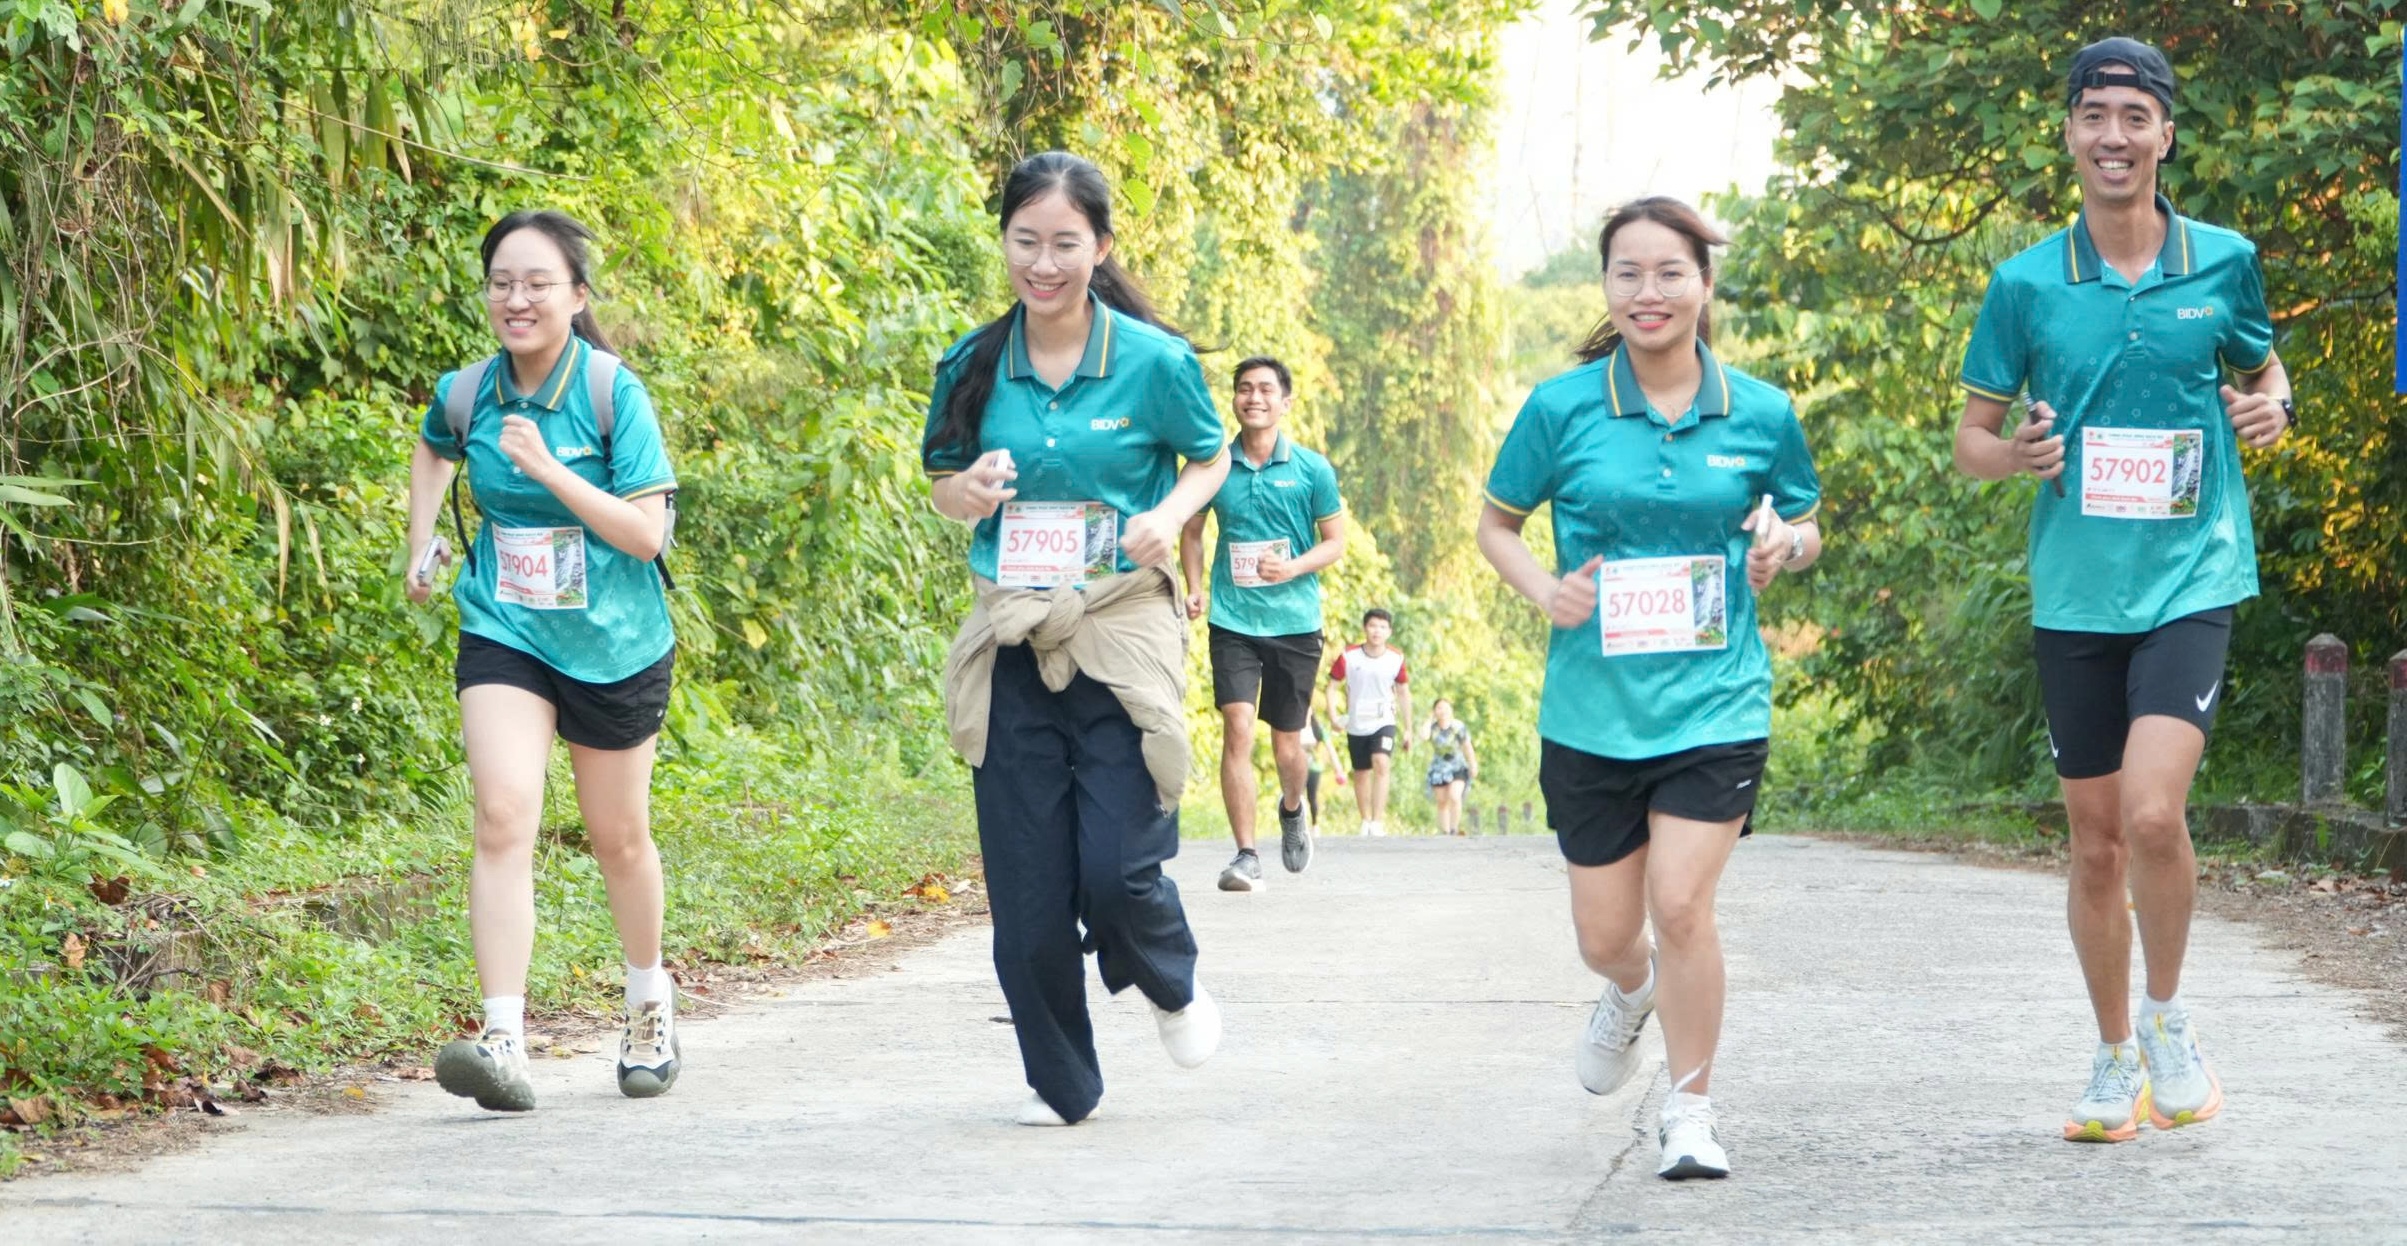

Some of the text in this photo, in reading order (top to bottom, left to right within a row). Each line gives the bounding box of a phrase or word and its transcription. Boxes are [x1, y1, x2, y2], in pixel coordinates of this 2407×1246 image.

[2176, 307, 2204, 320] BIDV
[1090, 418, 1120, 431] BIDV
[1706, 454, 1735, 468] BIDV
[2090, 456, 2166, 483] 57902
[1006, 528, 1079, 553] 57905
[499, 549, 548, 577] 57904
[1234, 557, 1255, 570] 579
[1608, 588, 1686, 619] 57028
